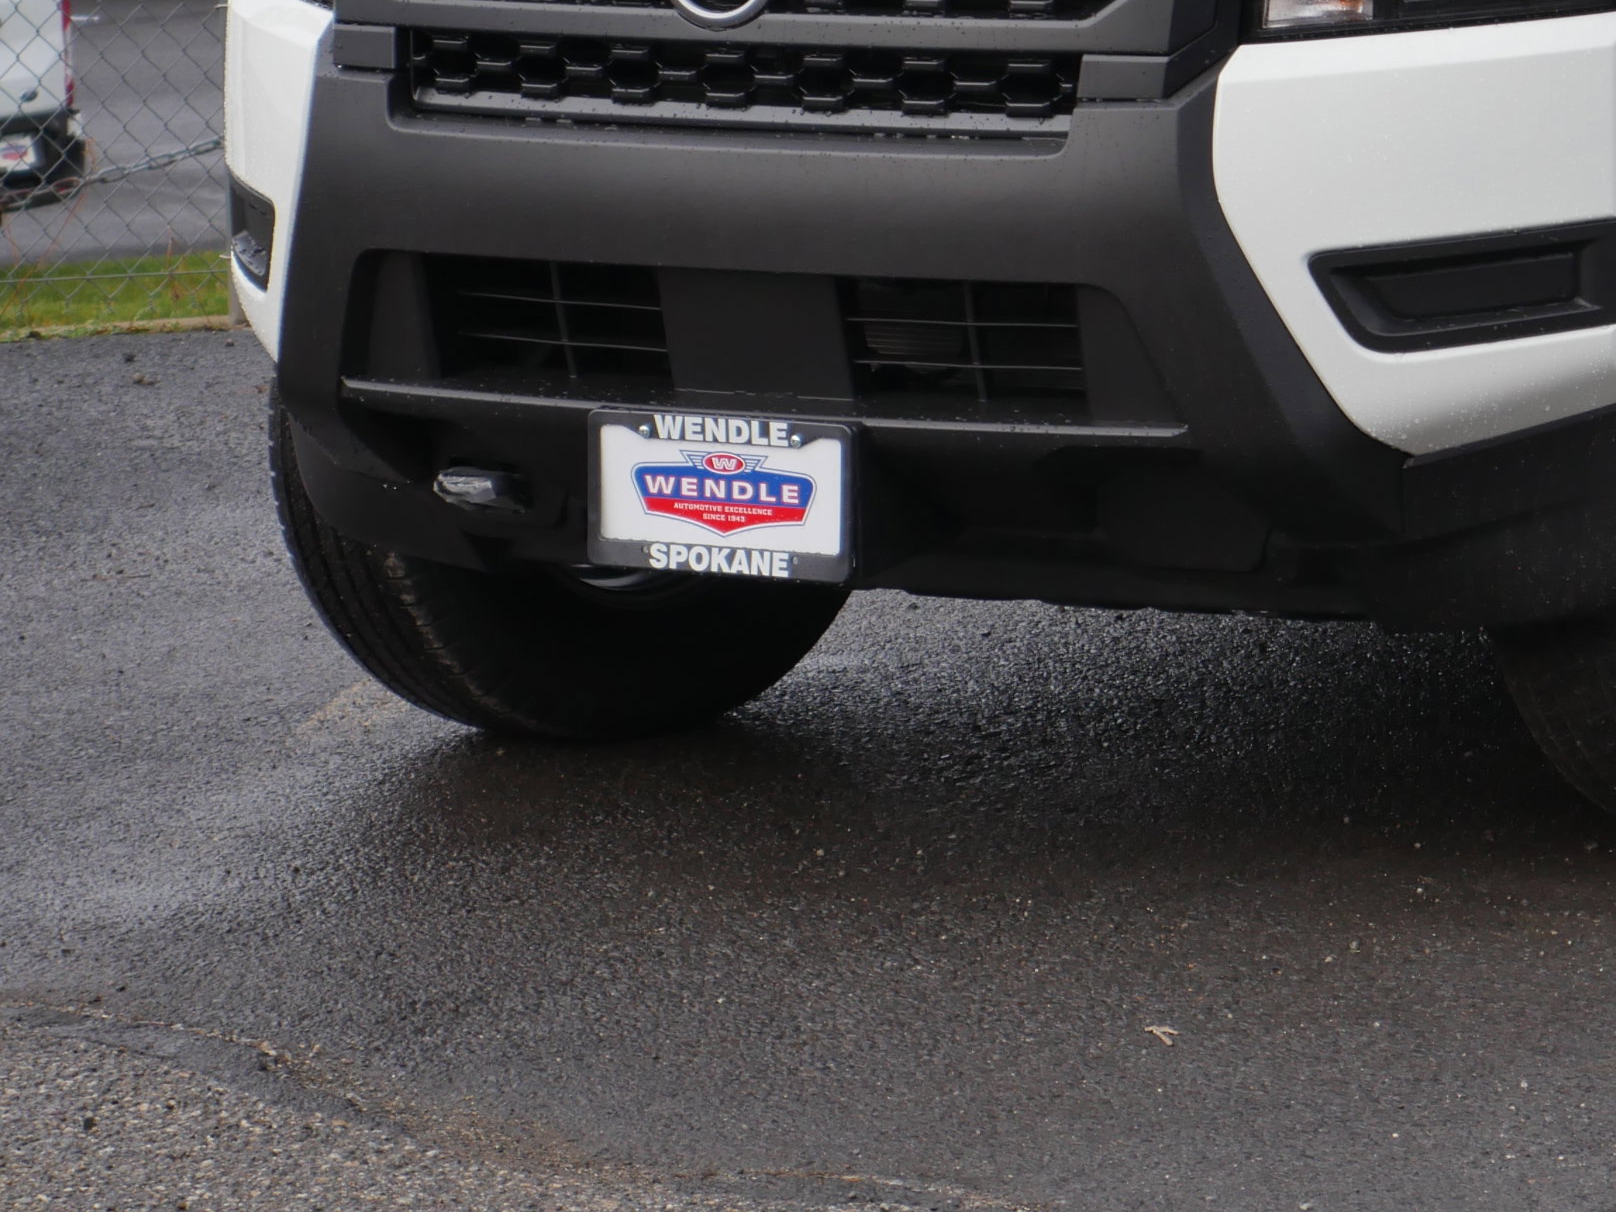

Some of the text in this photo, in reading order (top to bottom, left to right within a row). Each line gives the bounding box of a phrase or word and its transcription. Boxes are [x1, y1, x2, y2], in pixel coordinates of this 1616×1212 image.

[653, 414, 791, 448] WENDLE
[644, 475, 800, 504] WENDLE
[673, 502, 773, 516] AUTOMOTIVE EXCELLENCE
[702, 513, 746, 523] SINCE 1943
[649, 542, 790, 578] SPOKANE
